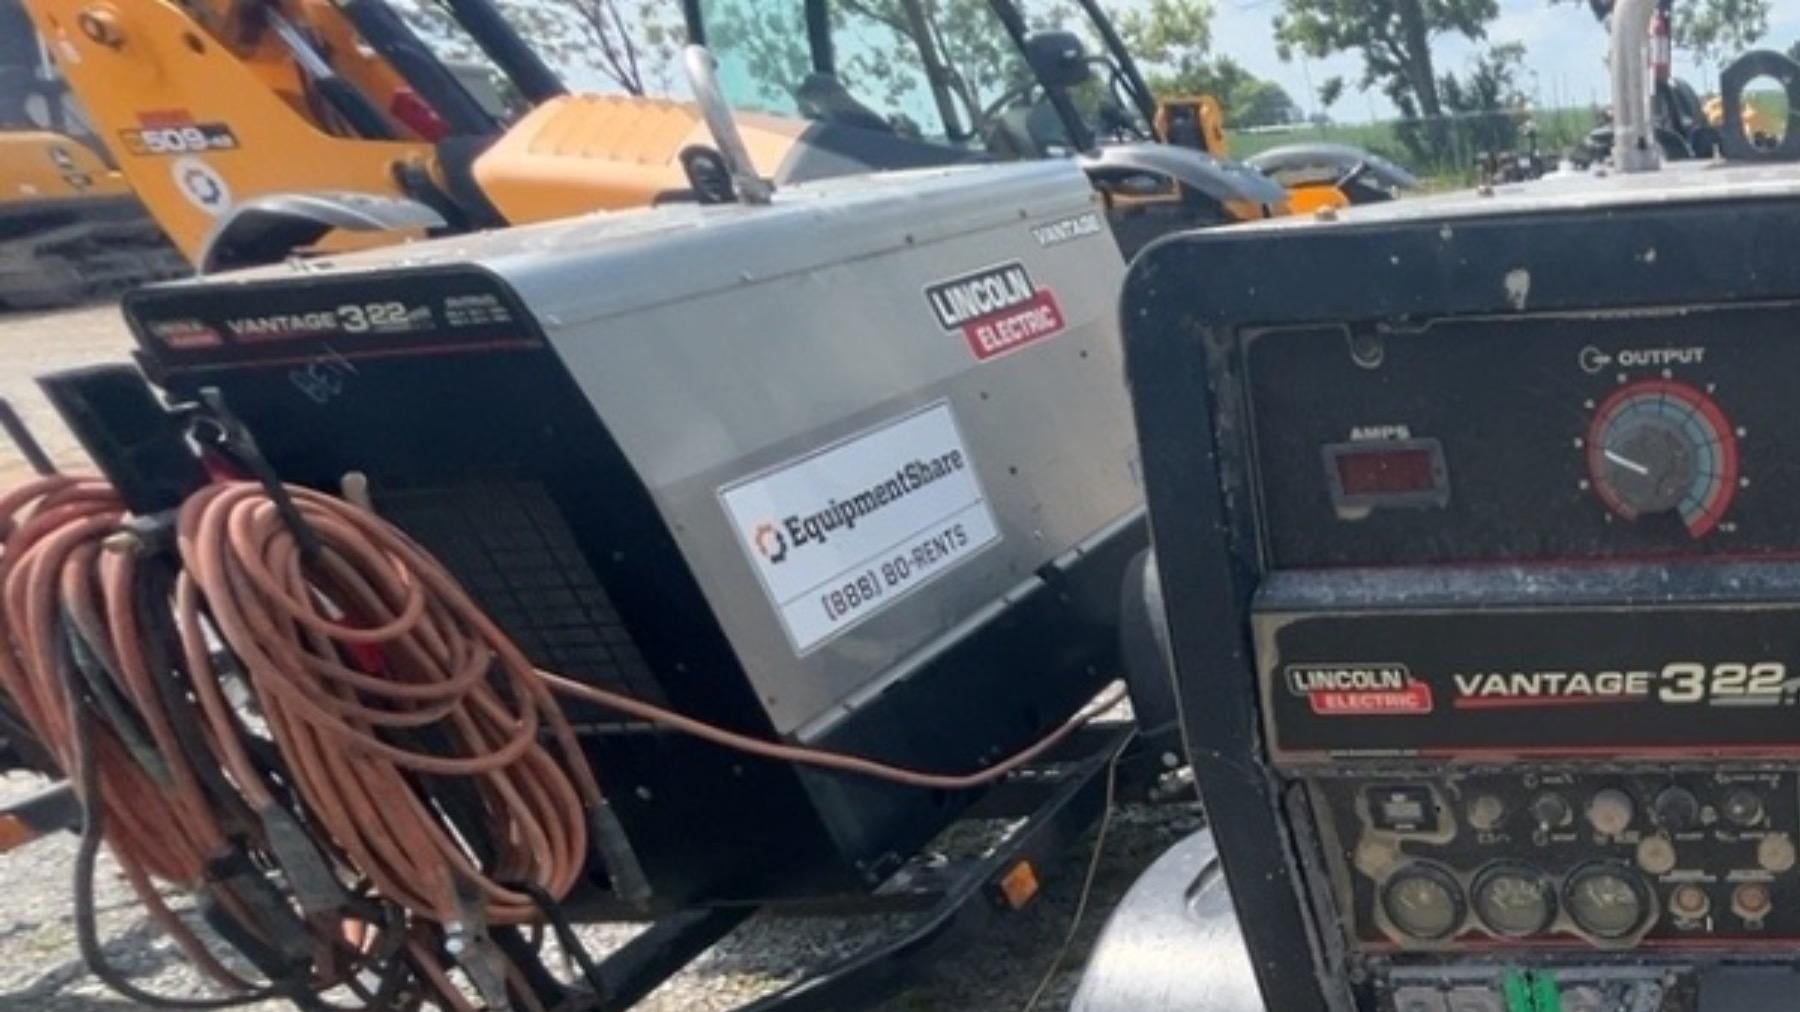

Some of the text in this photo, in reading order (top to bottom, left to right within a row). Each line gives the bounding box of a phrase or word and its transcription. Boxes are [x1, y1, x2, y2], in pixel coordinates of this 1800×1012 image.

[931, 268, 1033, 326] LINCOLN
[226, 310, 337, 334] VANTAGE
[337, 301, 409, 334] 322
[975, 304, 1058, 352] ELECTRIC
[1617, 347, 1705, 367] OUTPUT
[1349, 424, 1410, 440] AMPS
[783, 448, 965, 547] EquipmentShare
[820, 522, 969, 622] (888) 80-RENTS
[1294, 669, 1401, 691] LINCOLN
[1453, 671, 1648, 697] VANTAGE
[1659, 662, 1788, 702] 322
[1324, 692, 1421, 709] ELECTRIC
